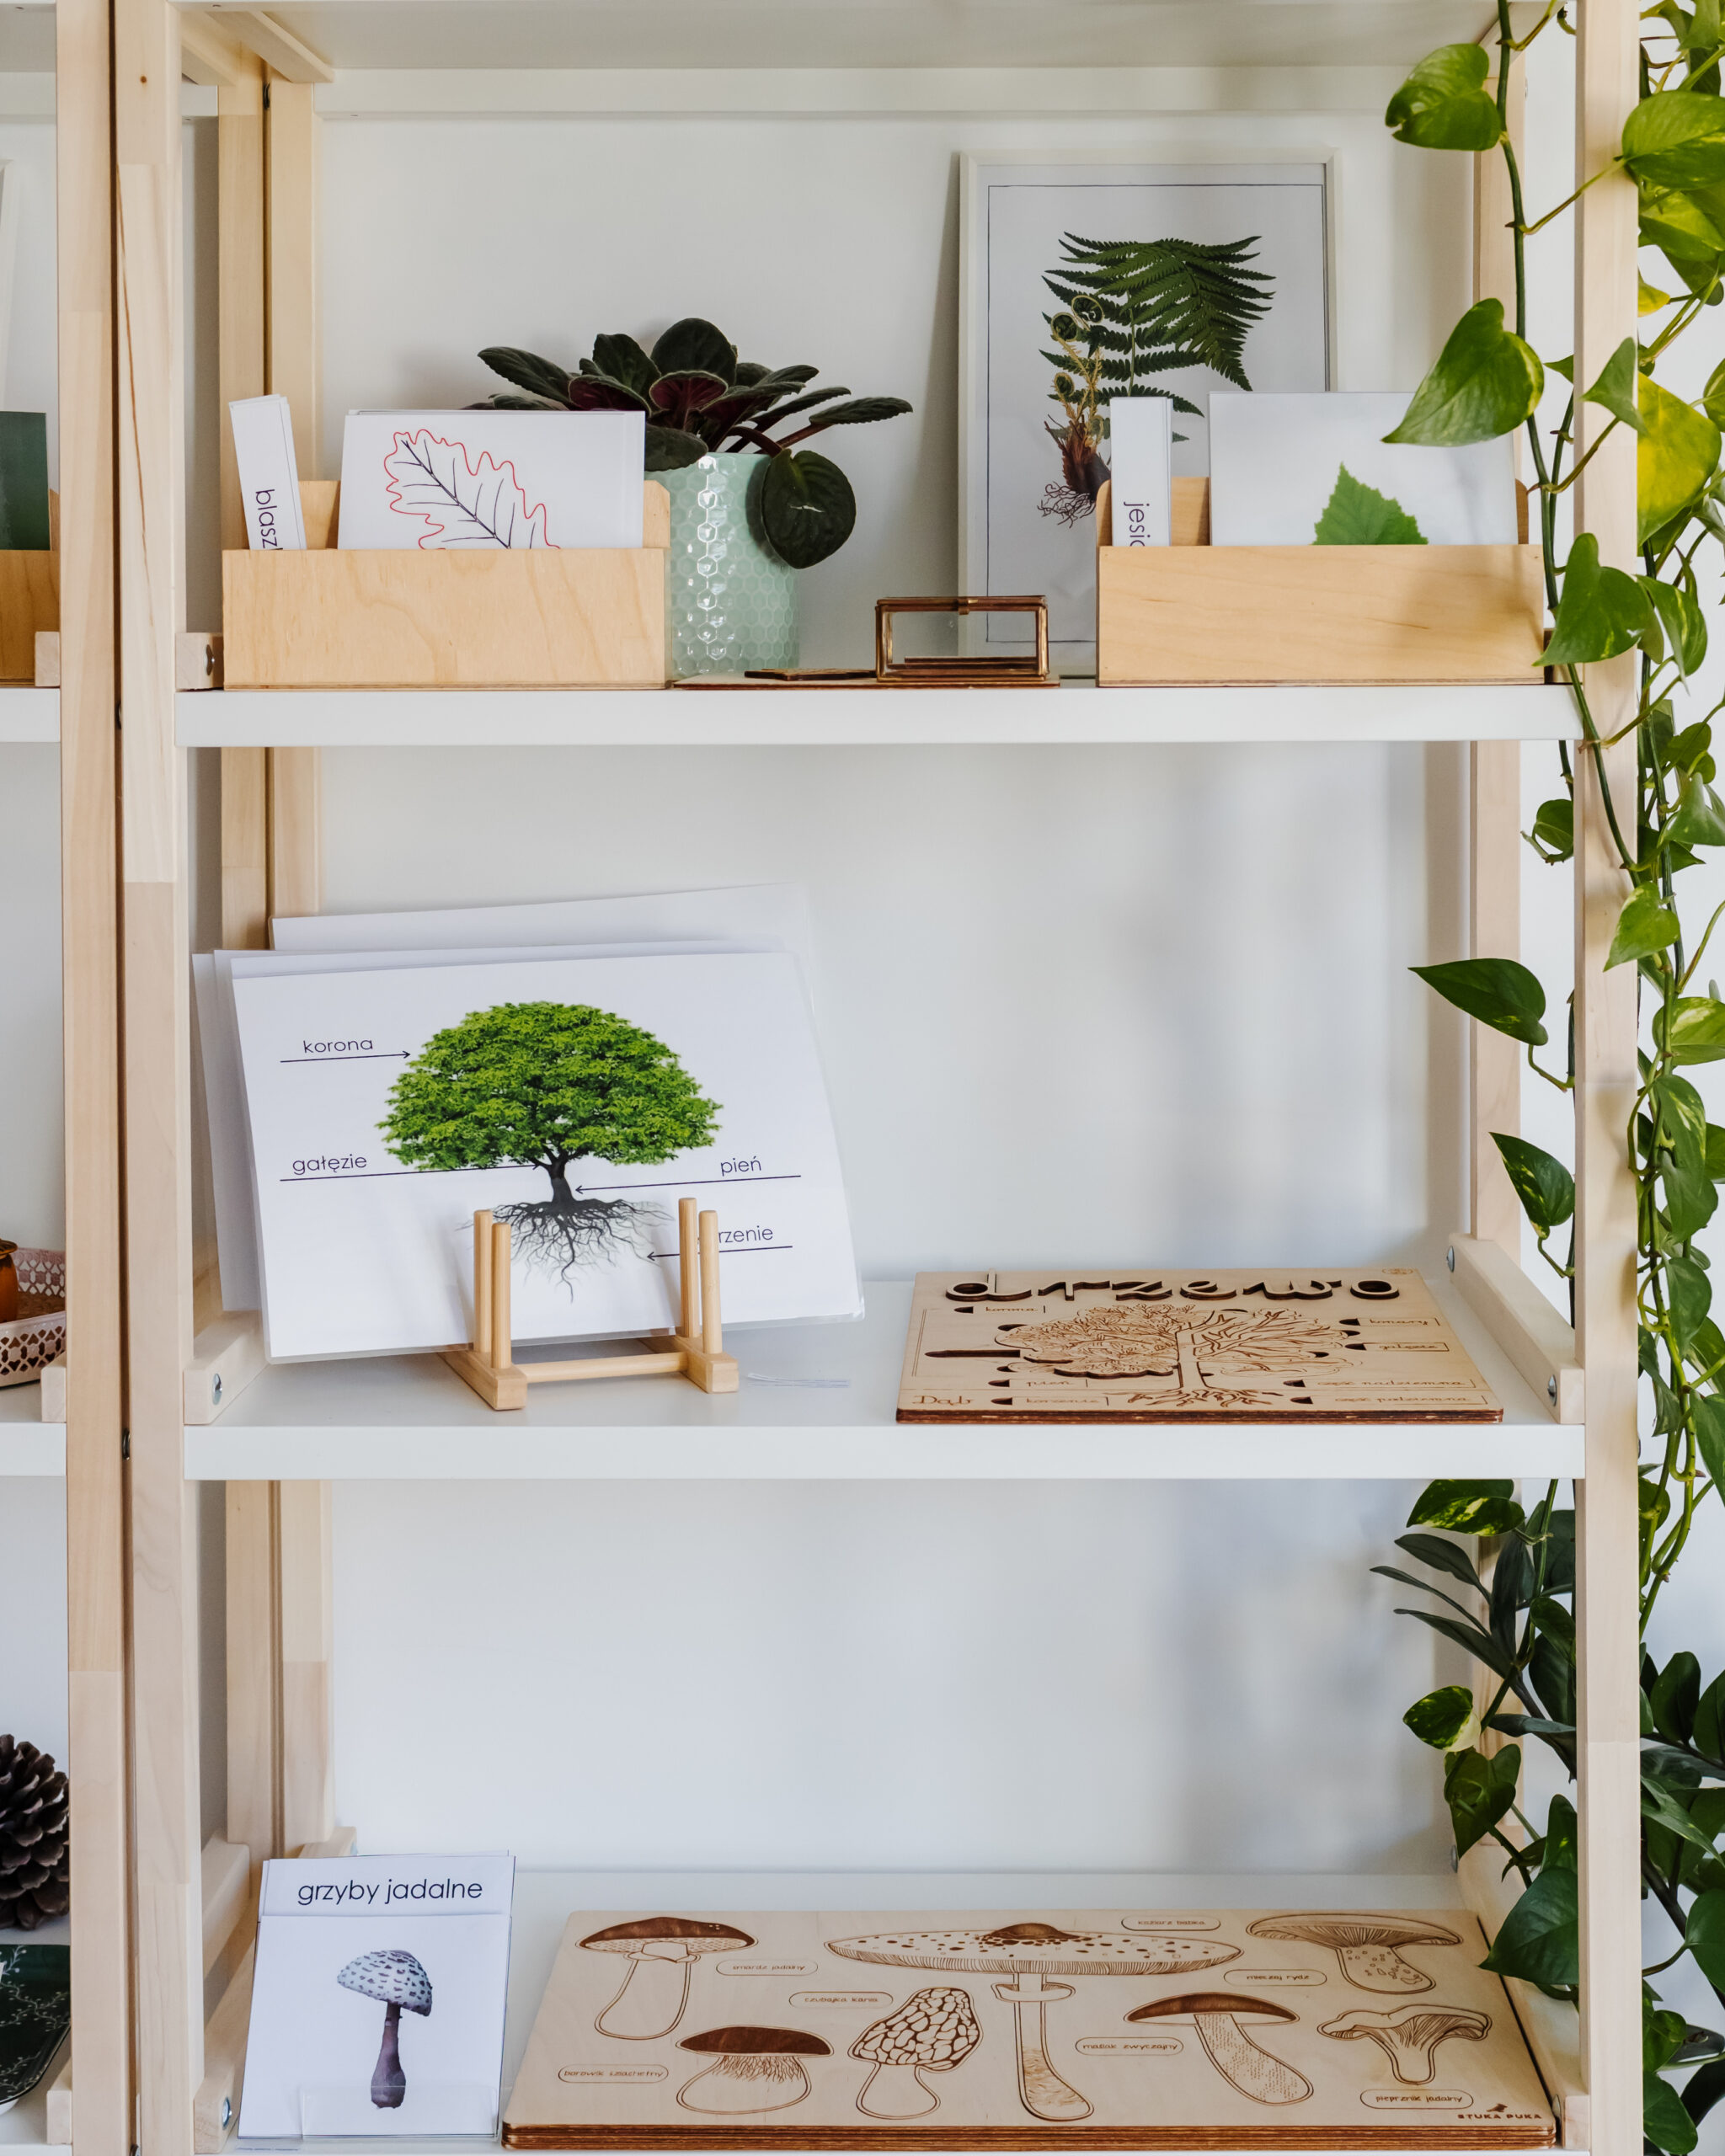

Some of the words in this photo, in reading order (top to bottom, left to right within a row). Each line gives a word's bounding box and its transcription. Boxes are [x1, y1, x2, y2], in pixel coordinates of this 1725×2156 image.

[255, 488, 283, 550] blasz
[303, 1039, 373, 1053] korona
[292, 1153, 367, 1176] gałęzie
[720, 1155, 761, 1177] pień
[718, 1225, 773, 1243] rzenie
[944, 1268, 1400, 1301] drzewo
[297, 1879, 380, 1906] grzyby
[384, 1878, 483, 1905] jadalne
[1285, 1973, 1310, 1982] rydz
